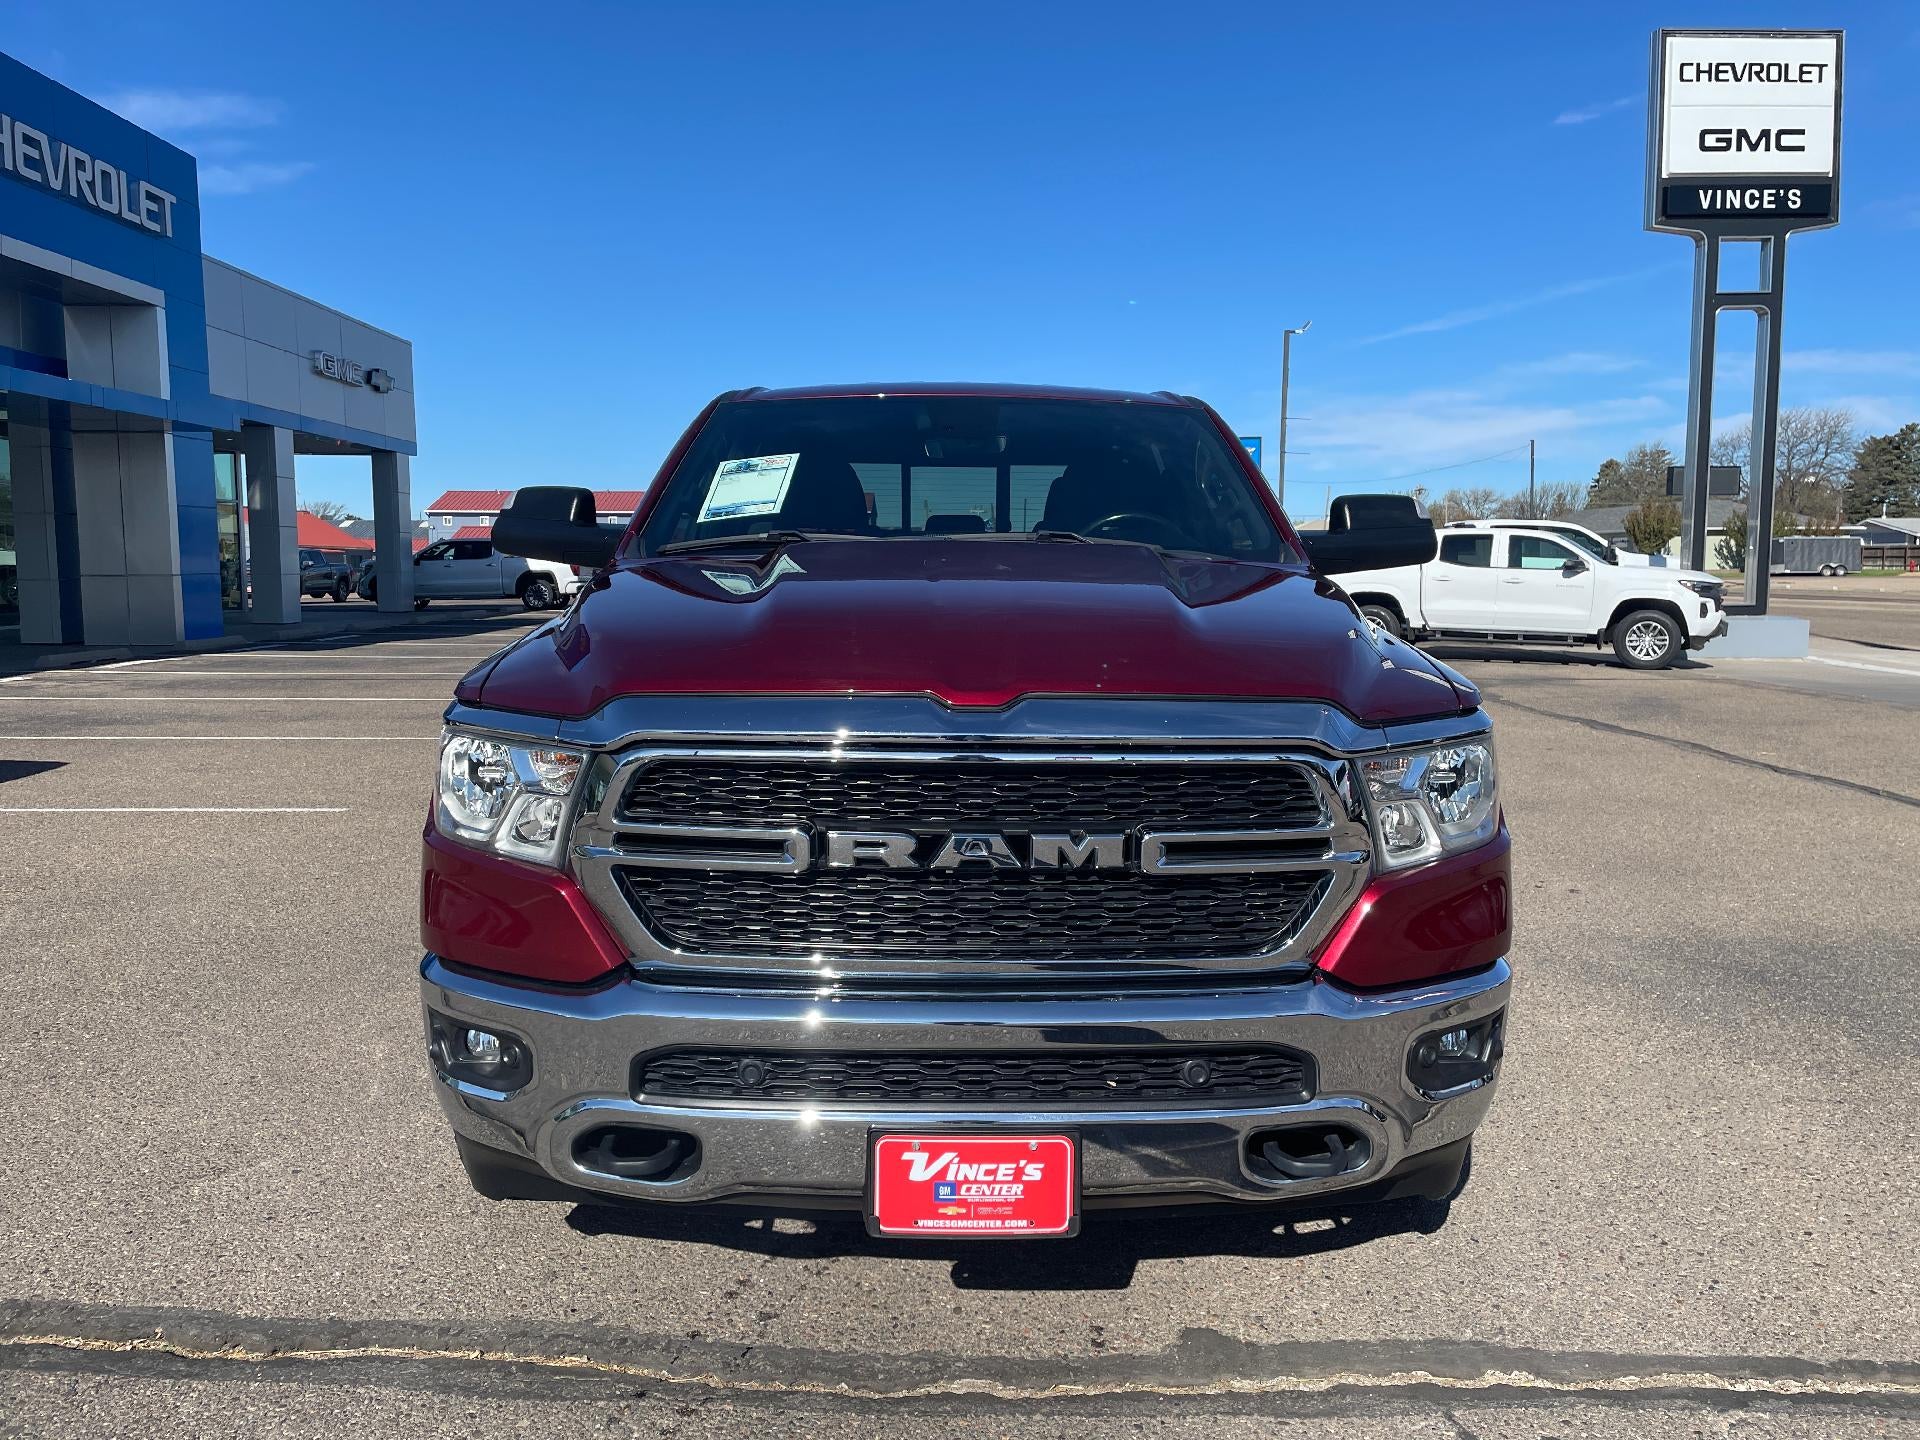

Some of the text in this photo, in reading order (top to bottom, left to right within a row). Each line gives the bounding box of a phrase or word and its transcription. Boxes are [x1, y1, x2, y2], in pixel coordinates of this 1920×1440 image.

[1679, 62, 1829, 83] CHEVROLET
[1699, 128, 1806, 152] GMC
[1699, 188, 1803, 210] VINCE'S
[317, 351, 364, 387] GMC
[826, 830, 1126, 869] RAM
[960, 1183, 1024, 1196] CENTER
